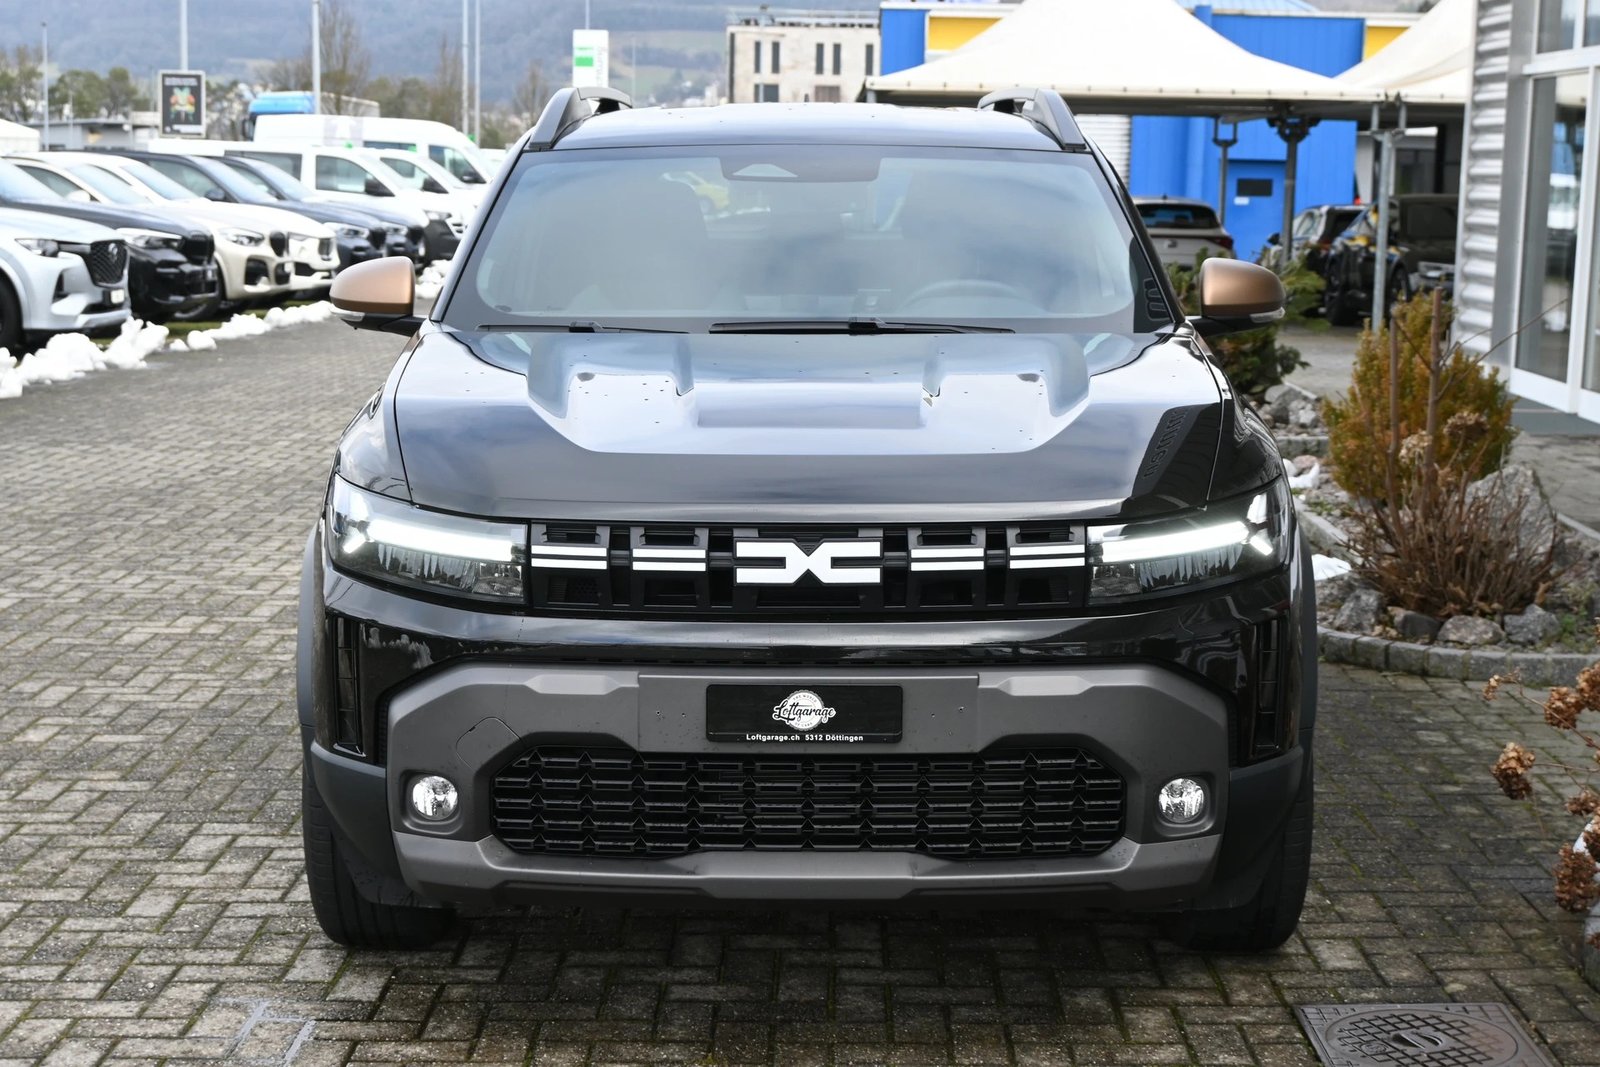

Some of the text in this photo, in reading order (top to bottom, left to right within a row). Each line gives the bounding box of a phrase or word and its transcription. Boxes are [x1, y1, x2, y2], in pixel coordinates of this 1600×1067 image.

[773, 699, 835, 723] Loftgarage
[746, 733, 863, 743] Loftgarage.ch 5312 Döttingen
